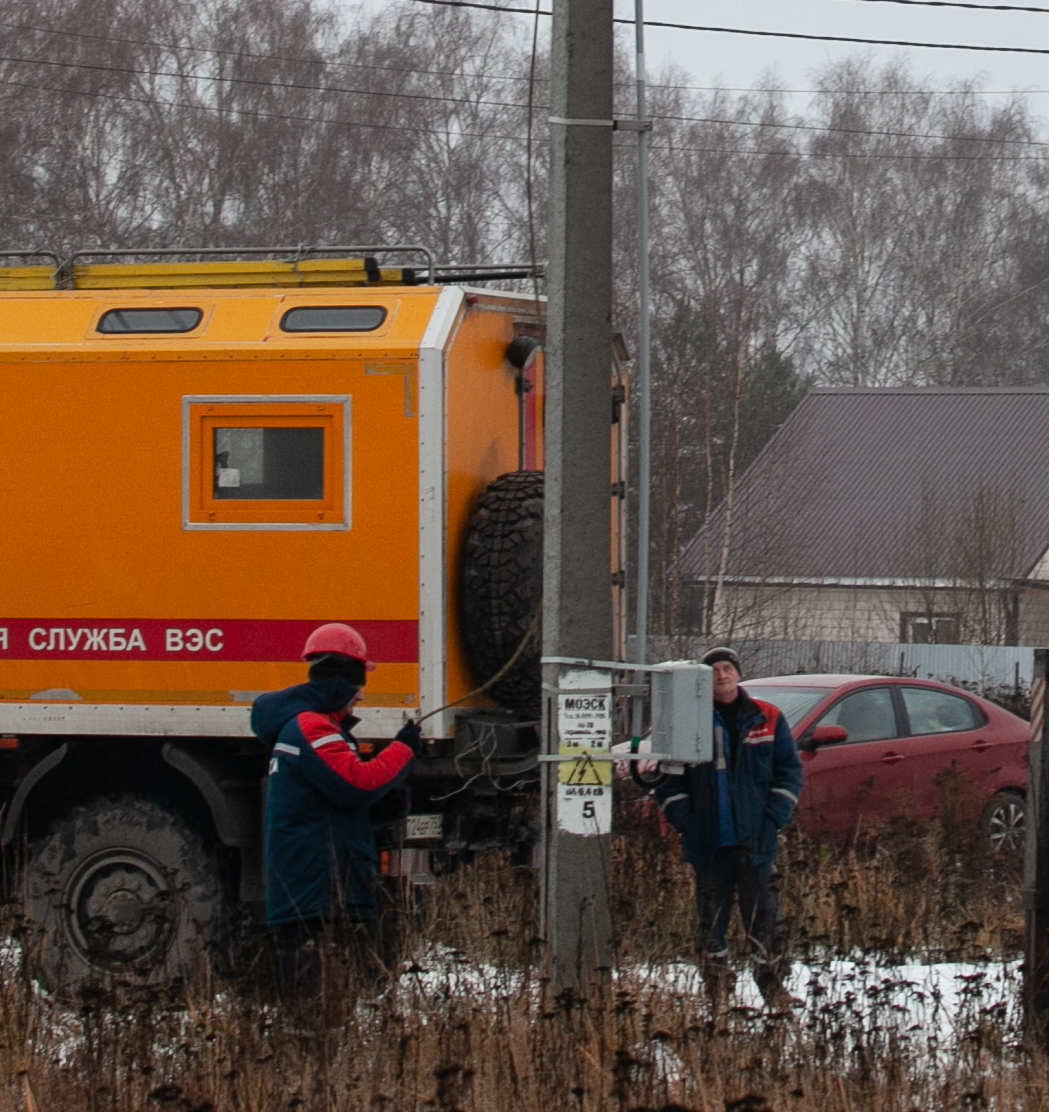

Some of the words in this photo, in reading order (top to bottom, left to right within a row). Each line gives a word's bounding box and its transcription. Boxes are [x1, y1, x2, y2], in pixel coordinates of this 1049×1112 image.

[28, 627, 147, 651] СЛУЖБА
[165, 628, 224, 652] ВЭС
[565, 698, 606, 711] МОЭСК
[582, 801, 595, 819] 5
